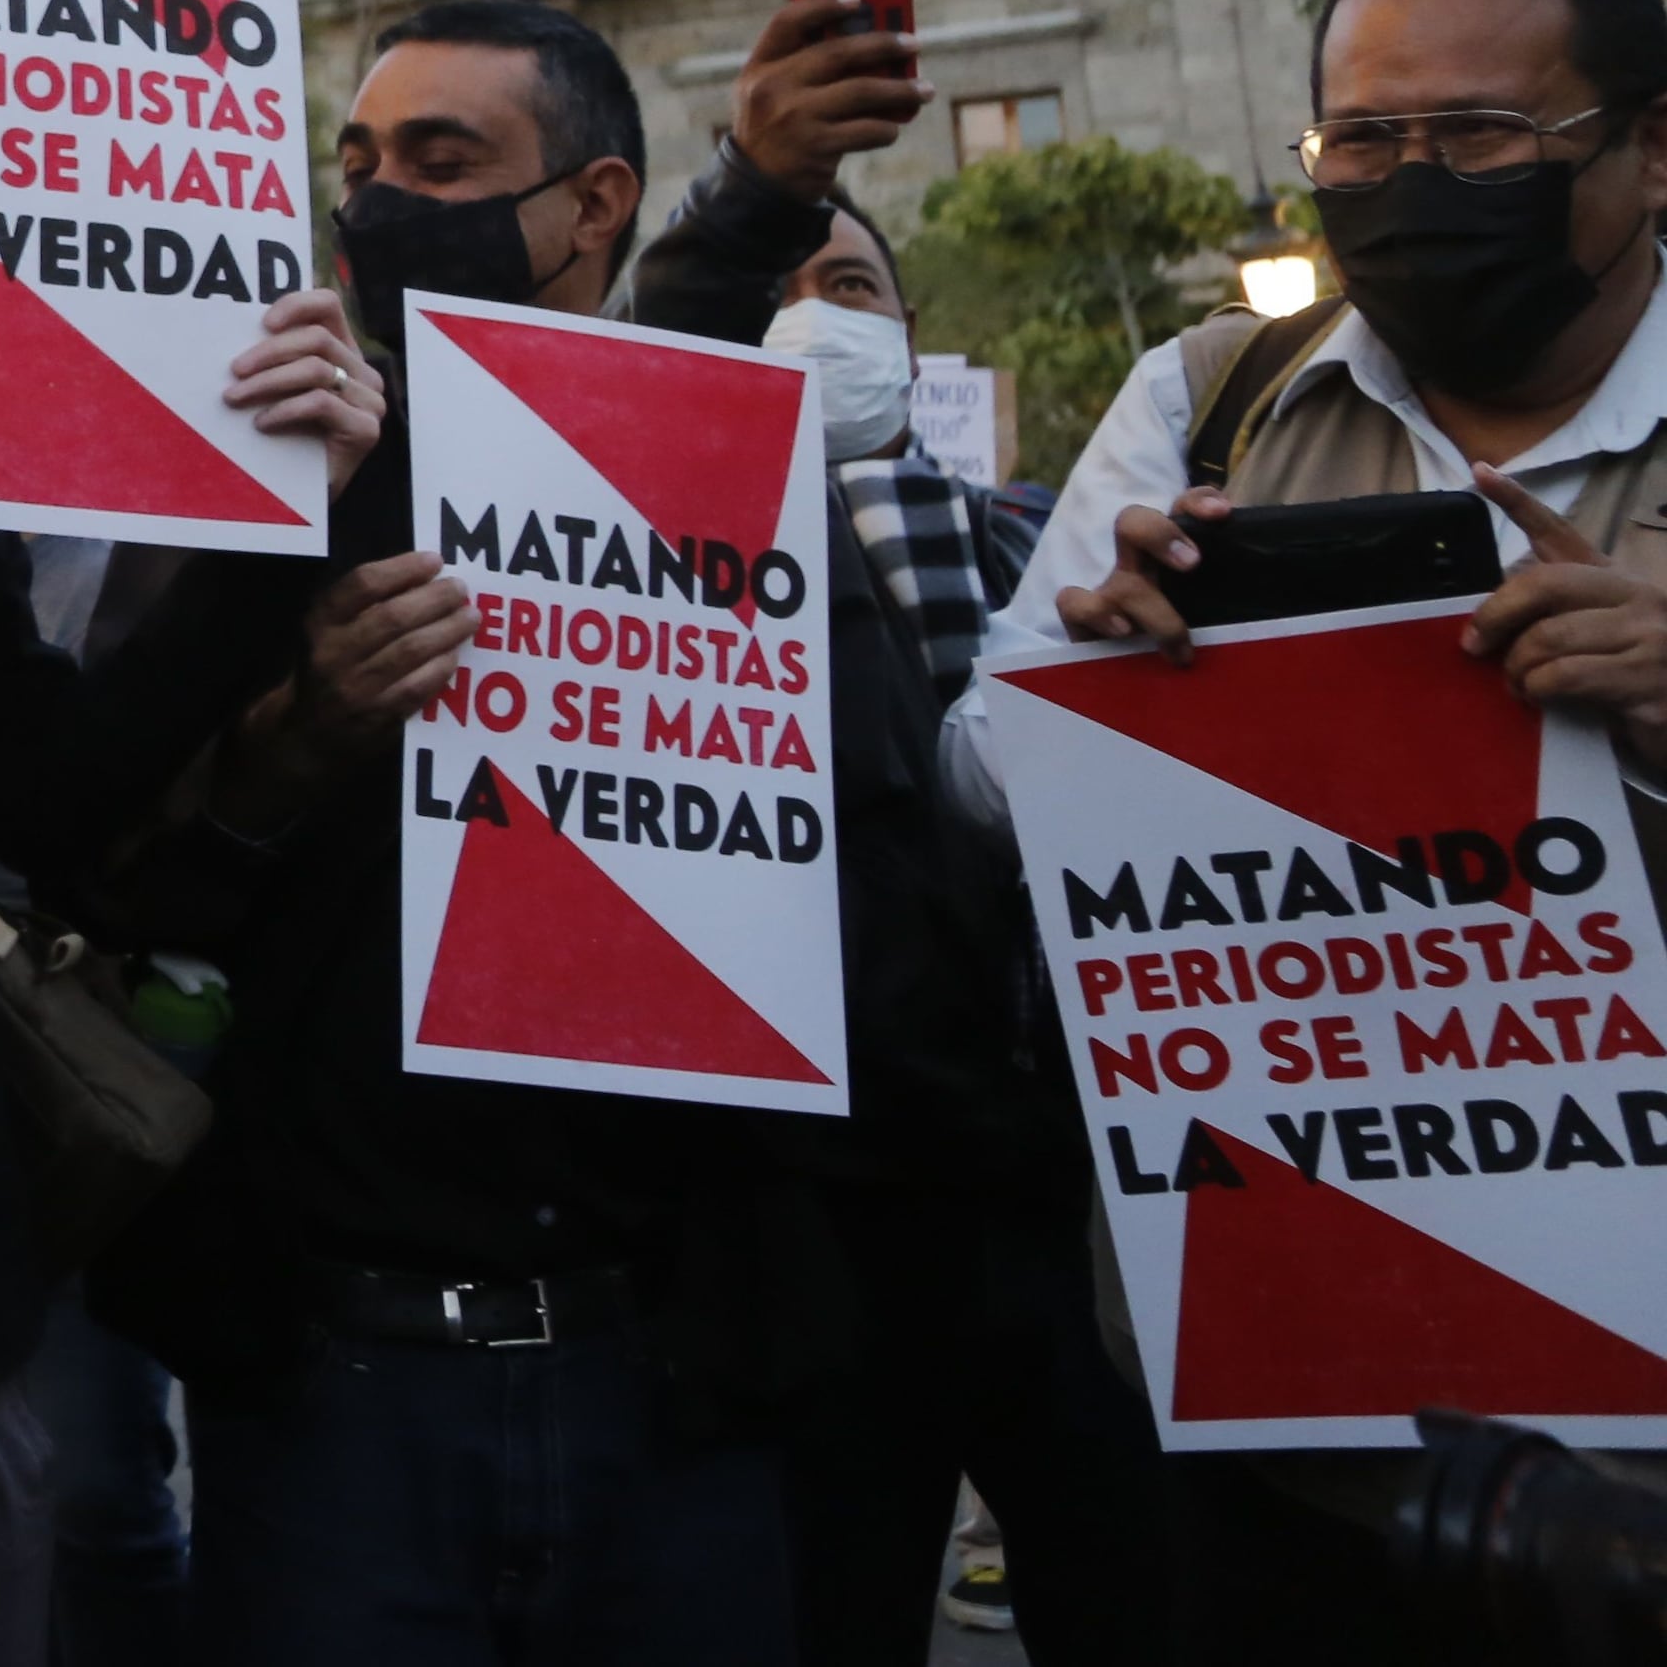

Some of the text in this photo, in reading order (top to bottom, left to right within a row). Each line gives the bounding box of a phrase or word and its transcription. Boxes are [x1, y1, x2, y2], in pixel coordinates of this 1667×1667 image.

[0, 131, 79, 195] SE
[108, 142, 296, 218] MATA
[439, 497, 805, 620] MATANDO
[464, 592, 808, 696] ERIODISTAS
[422, 666, 817, 775] NO SE MATA
[415, 747, 824, 864] LA VERDAD
[1062, 815, 1607, 939] MATANDO
[1077, 910, 1634, 1017] PERIODISTAS
[1088, 992, 1667, 1098] NO SE MATA
[1108, 1089, 1667, 1196] LA VERDAD
